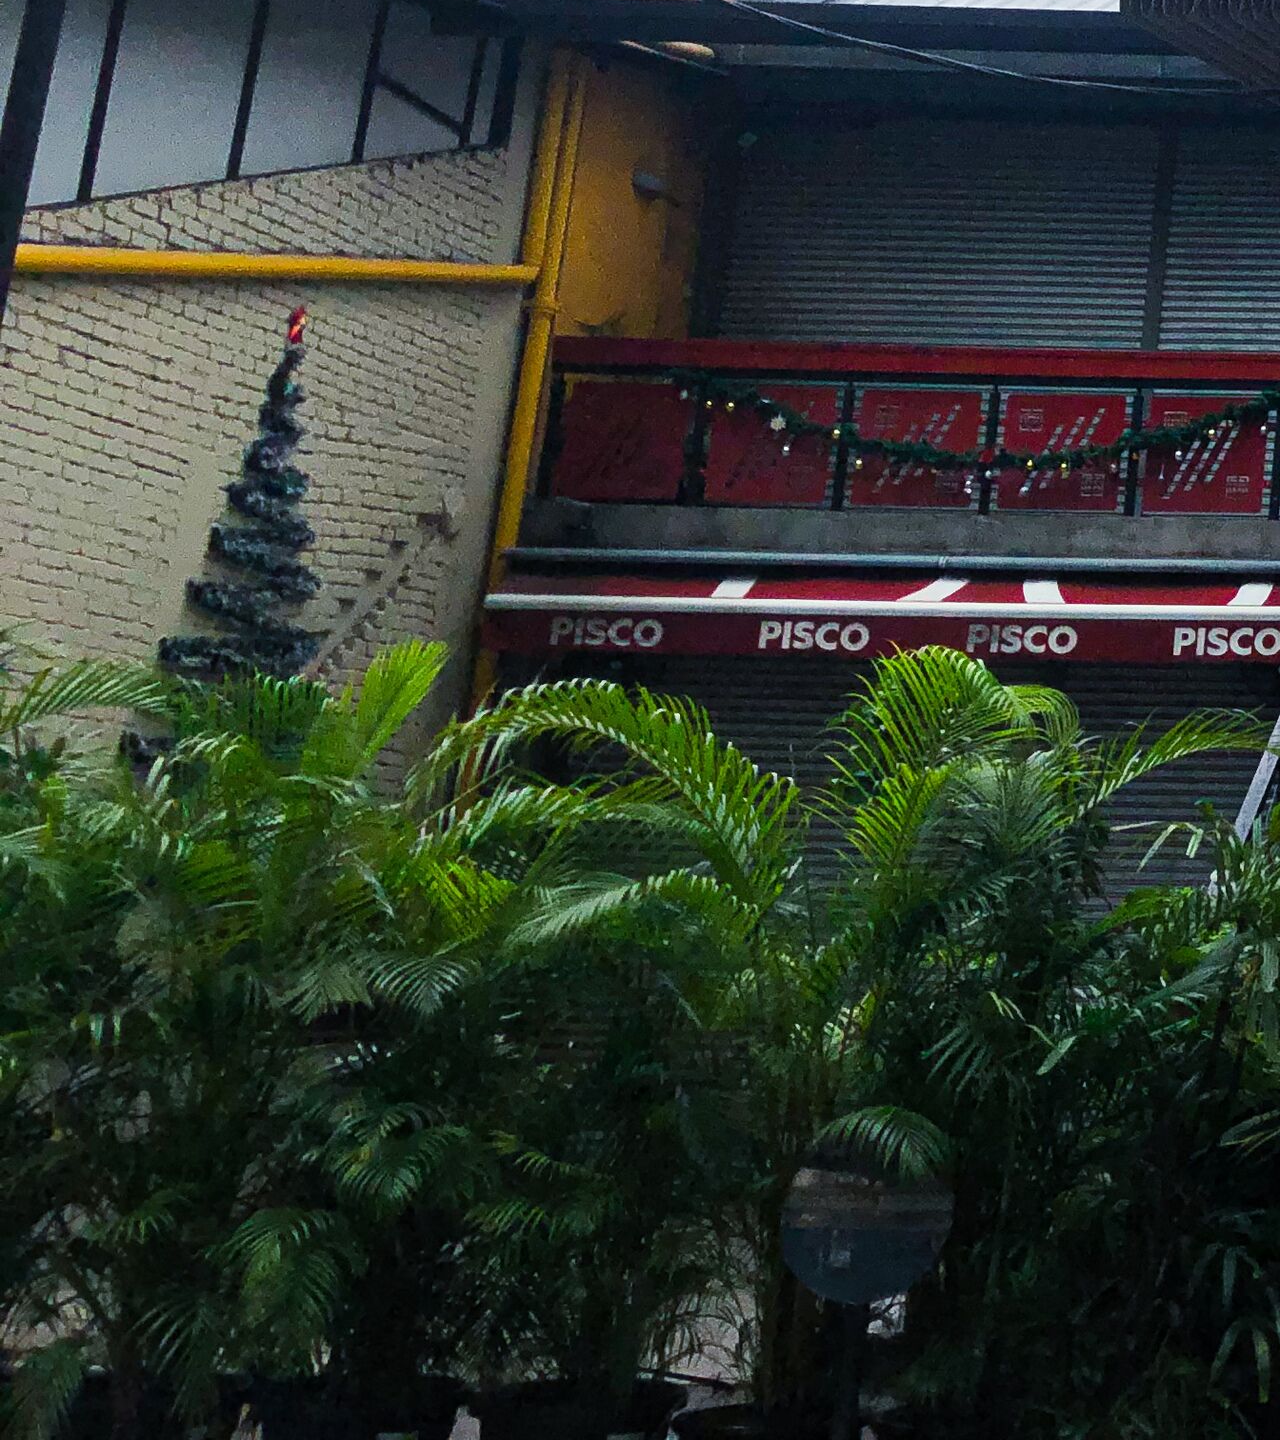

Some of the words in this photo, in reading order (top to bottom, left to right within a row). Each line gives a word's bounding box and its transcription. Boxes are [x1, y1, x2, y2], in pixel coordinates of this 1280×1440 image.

[550, 616, 664, 648] PISCO
[758, 620, 870, 652] PISCO
[965, 623, 1078, 655] PISCO
